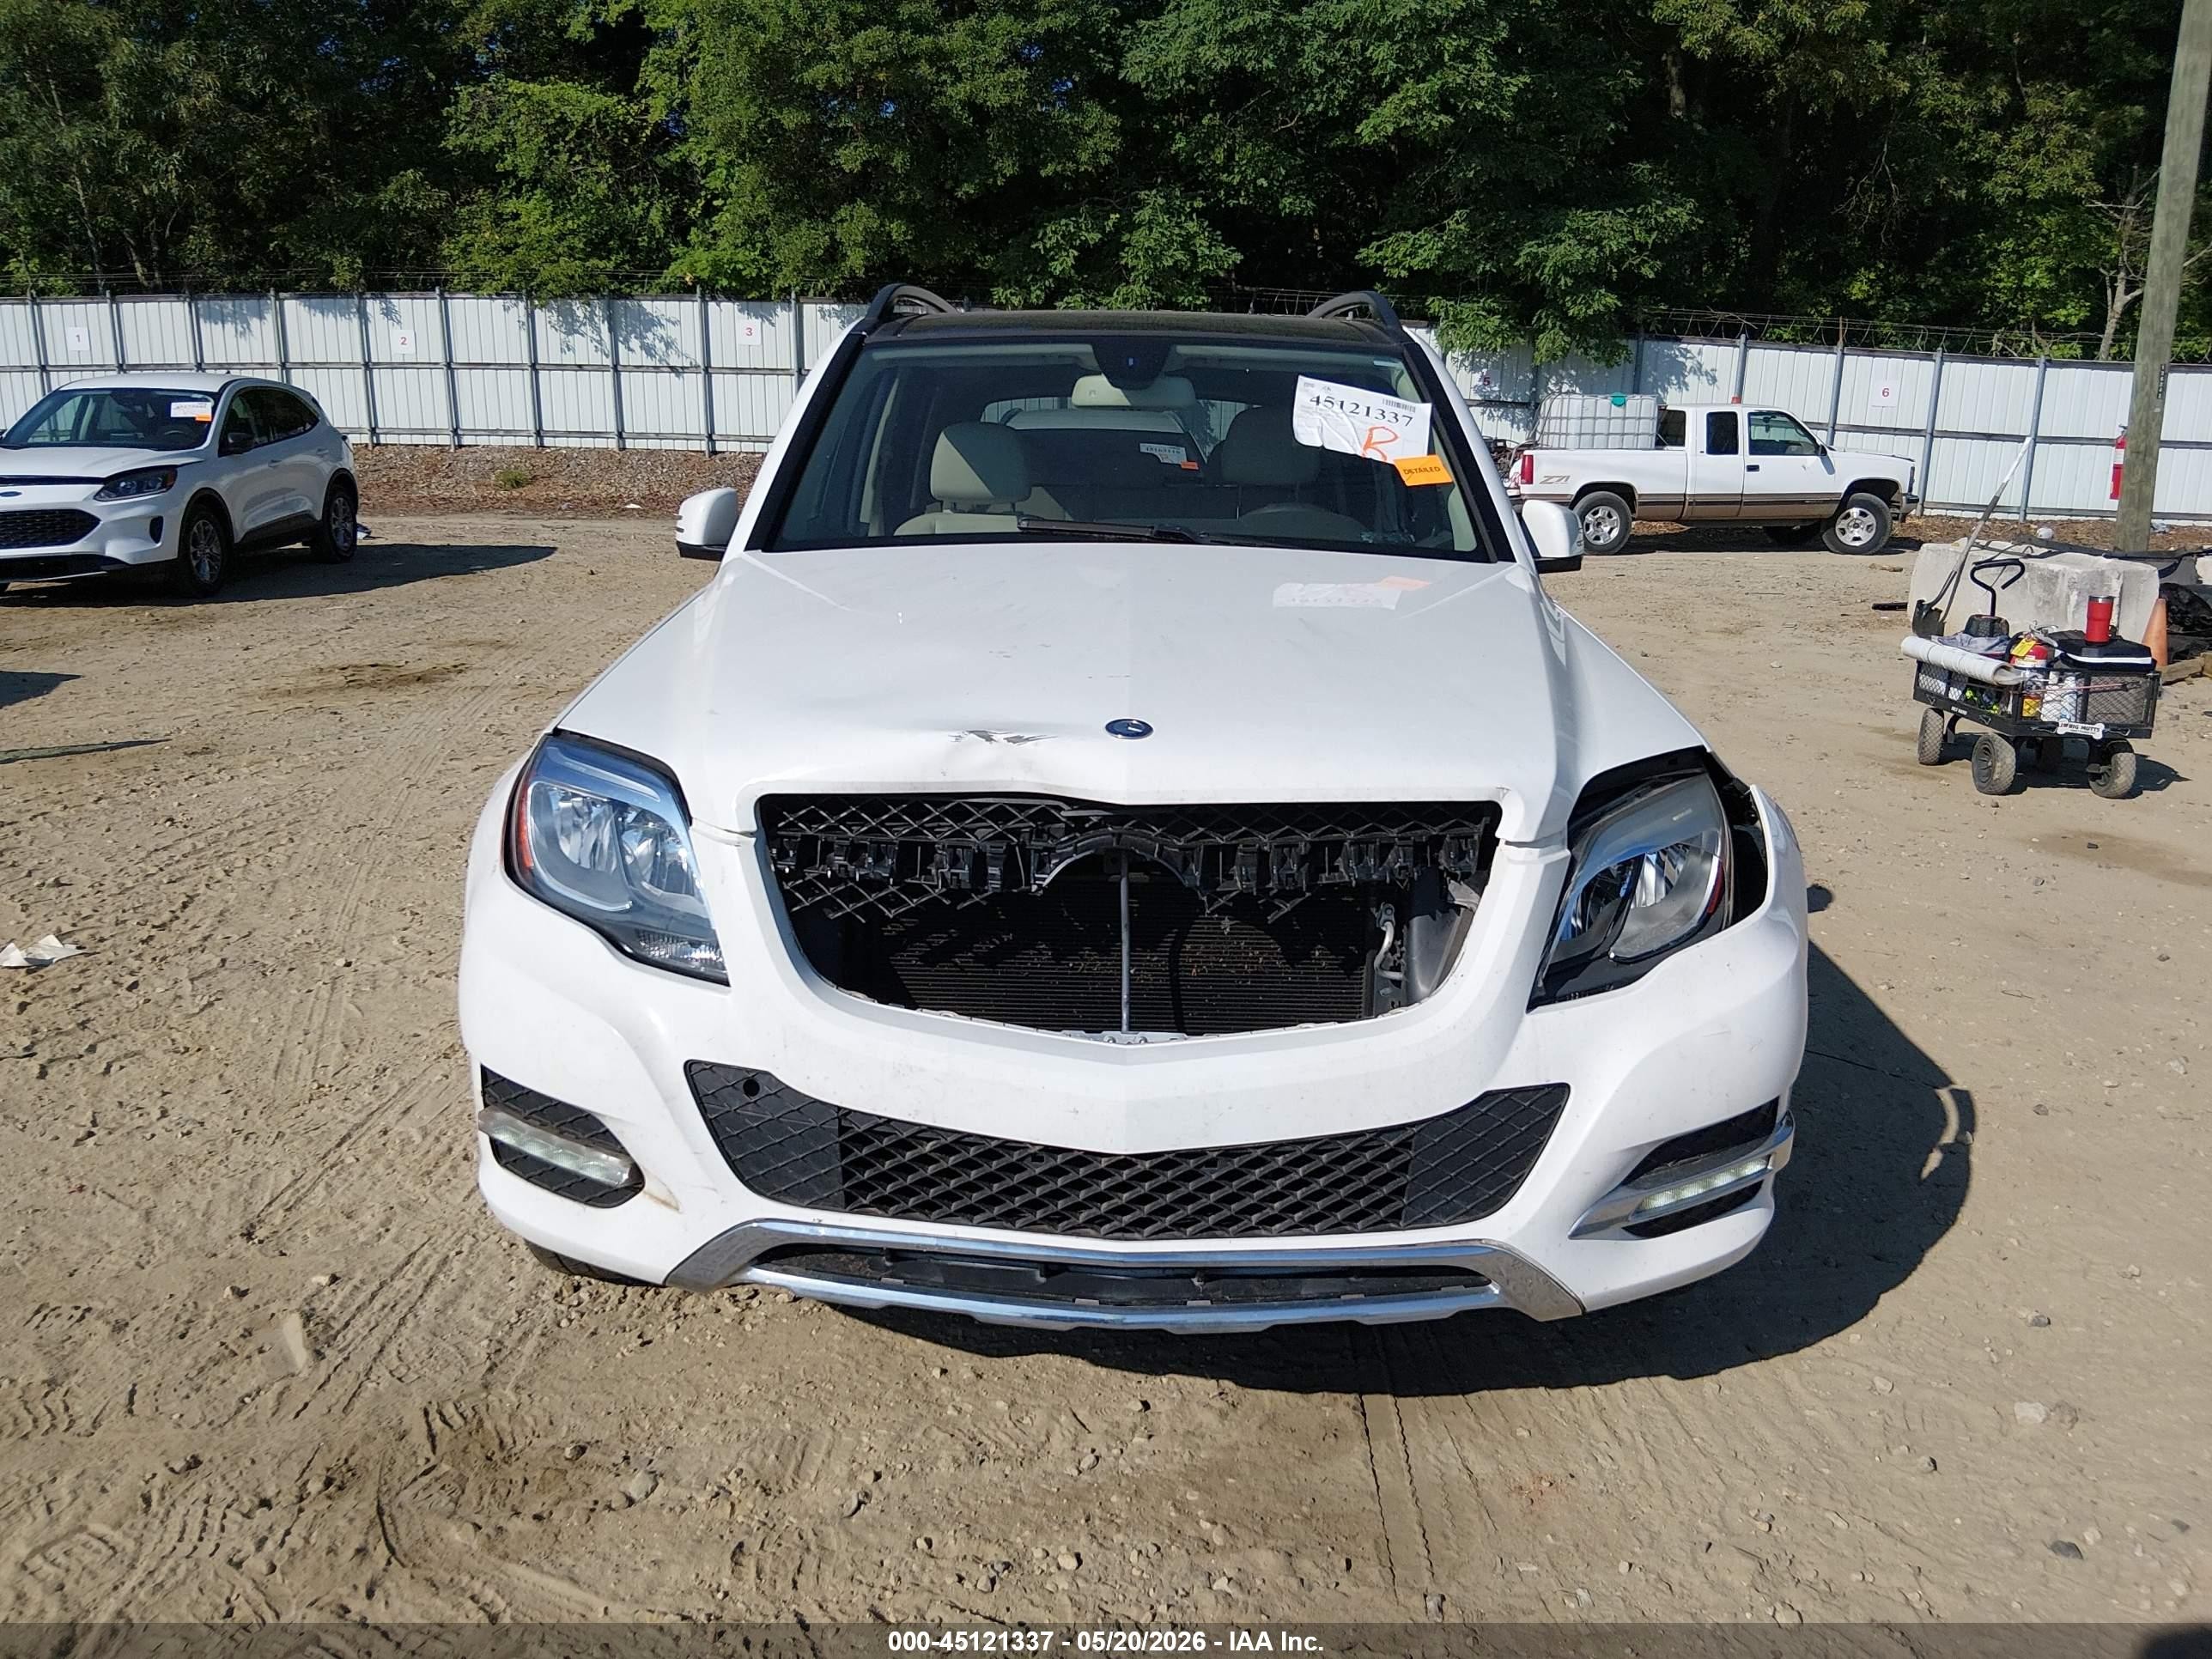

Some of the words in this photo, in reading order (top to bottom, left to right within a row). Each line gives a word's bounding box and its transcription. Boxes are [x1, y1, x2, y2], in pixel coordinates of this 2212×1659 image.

[745, 327, 753, 337] 3
[400, 337, 408, 345] 2
[1483, 376, 1491, 386] 5
[1881, 387, 1890, 398] 6
[1310, 395, 1413, 427] 45121337
[1361, 426, 1399, 461] R
[1403, 466, 1441, 475] DETAILED
[1539, 475, 1571, 485] Z71
